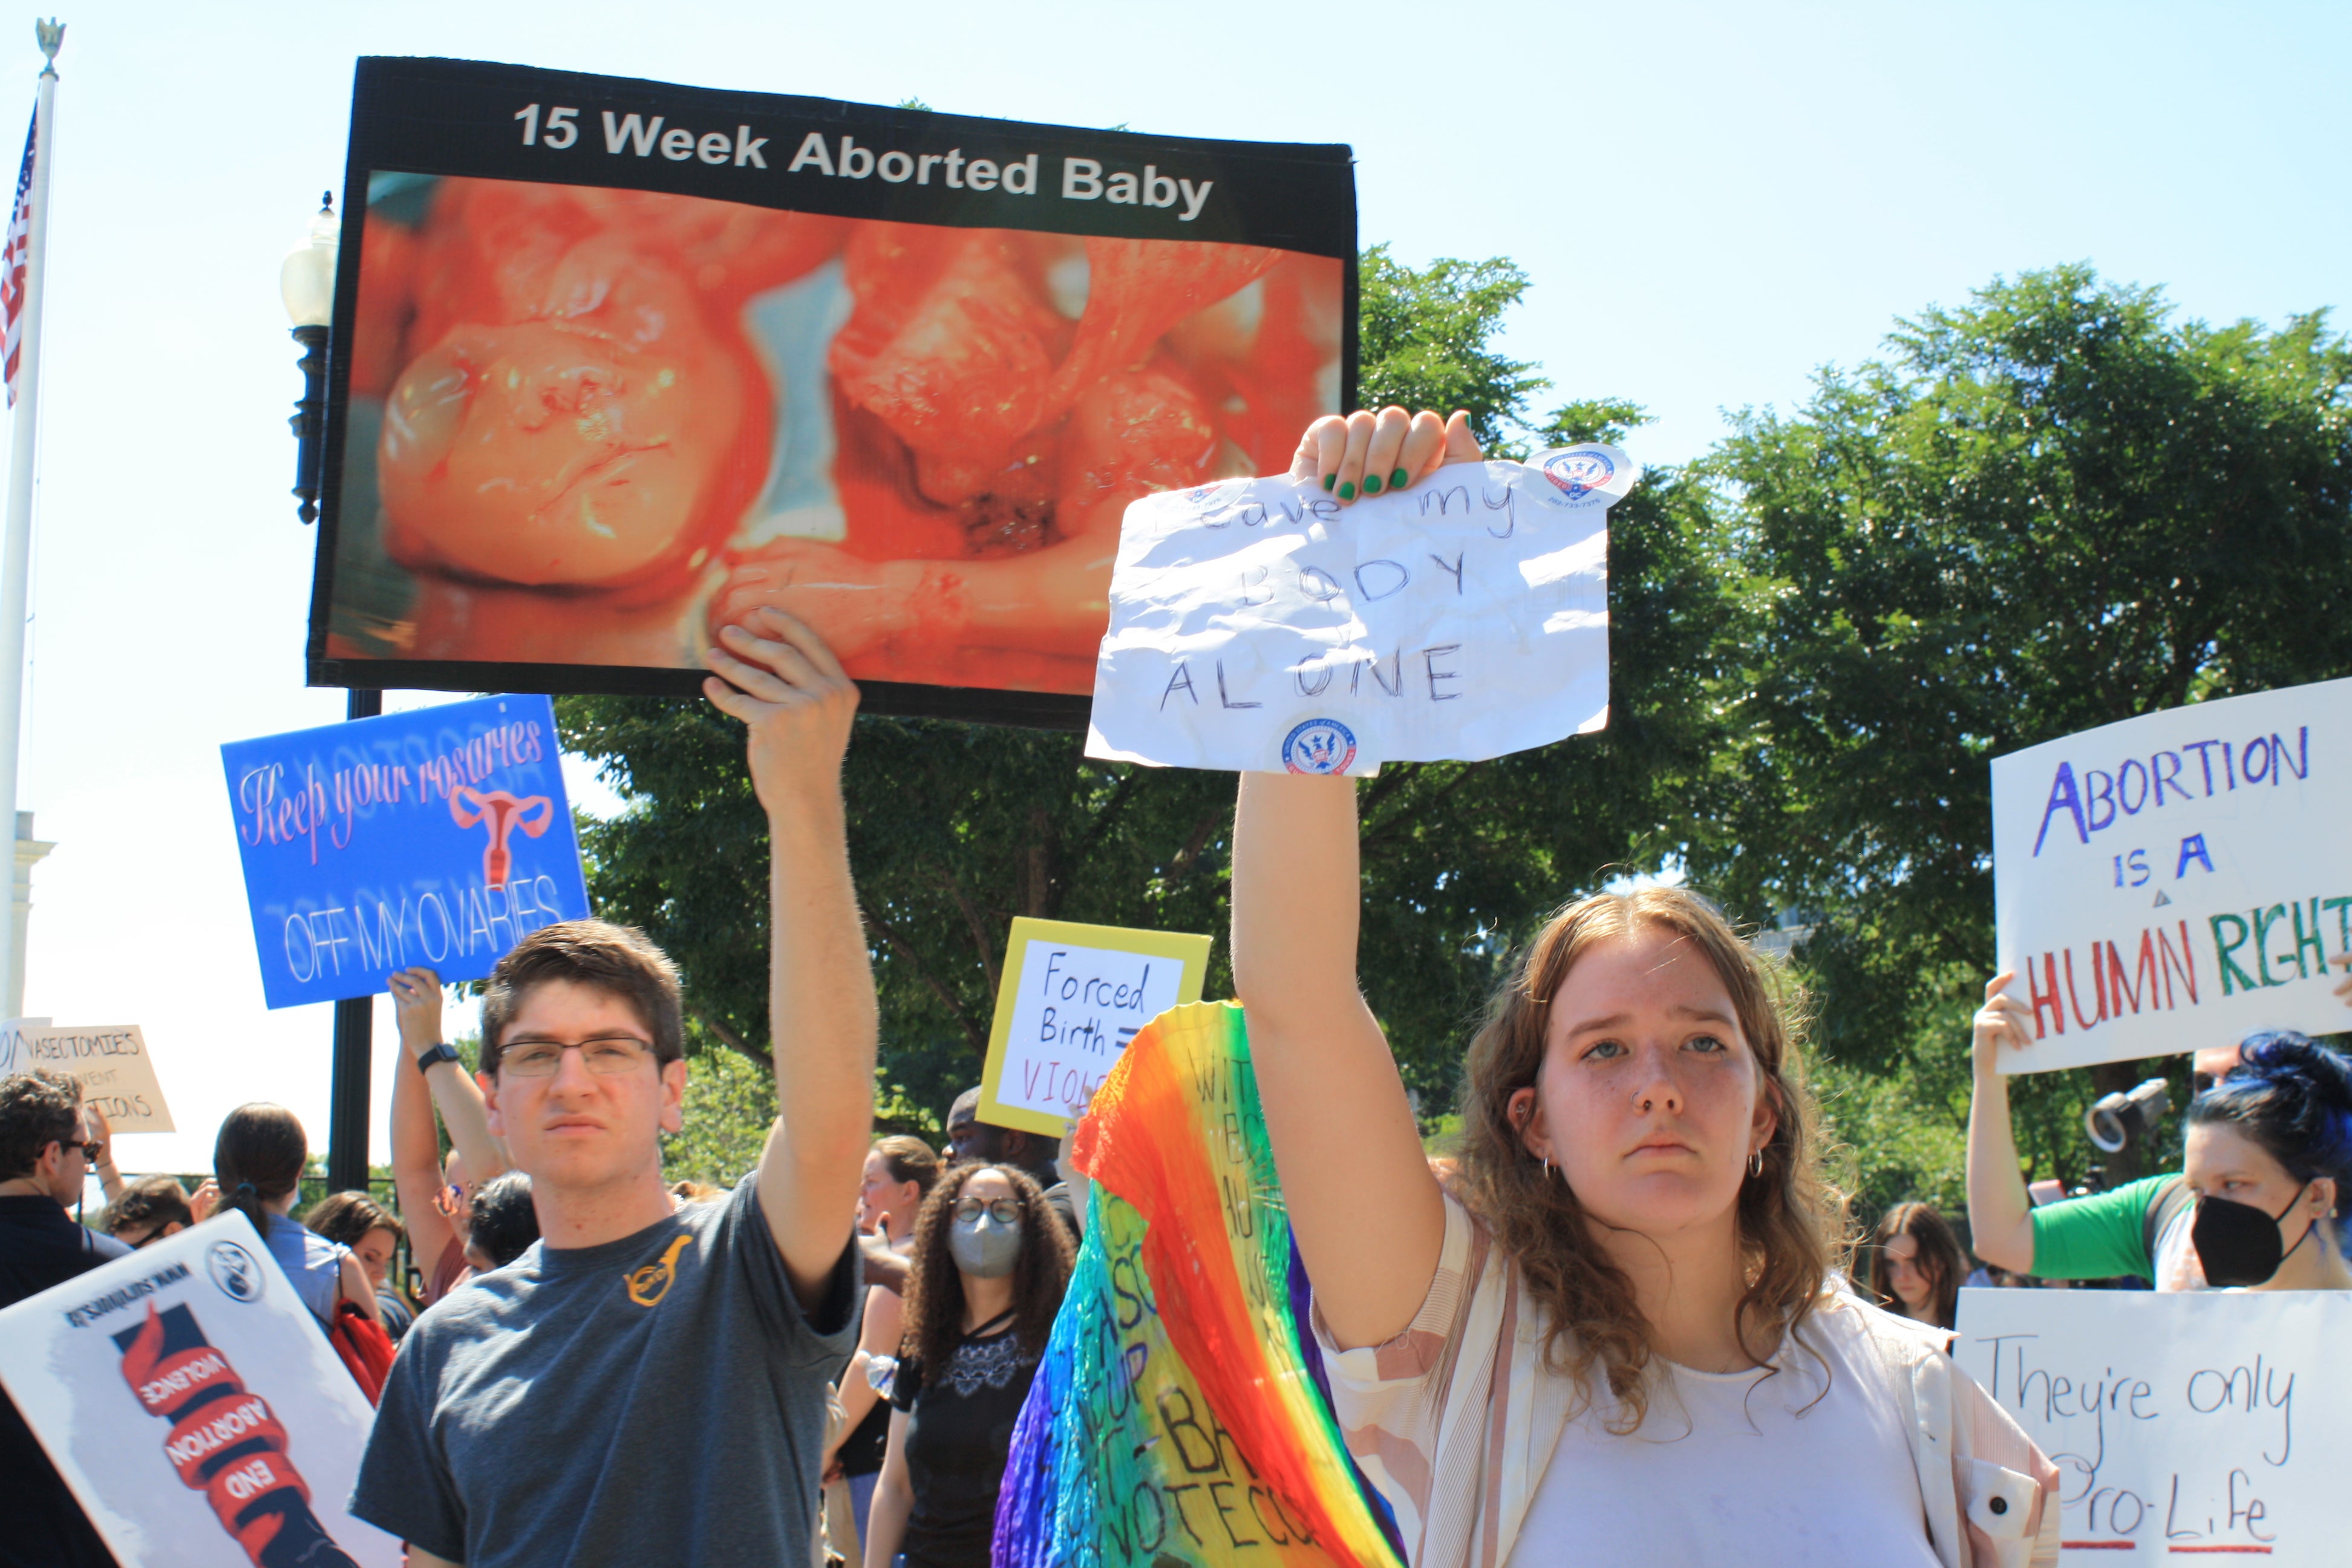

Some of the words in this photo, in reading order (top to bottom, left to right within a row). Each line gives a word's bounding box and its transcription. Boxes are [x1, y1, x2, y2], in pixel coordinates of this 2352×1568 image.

[514, 103, 580, 150] 15
[602, 111, 769, 169] Week
[789, 132, 1039, 195] Aborted
[1062, 157, 1214, 221] Baby
[1417, 482, 1515, 539] my
[1241, 551, 1464, 607] BODY
[1159, 642, 1463, 713] ALONE
[240, 762, 325, 866] Keep
[331, 763, 411, 849] your
[419, 702, 543, 804] rosaries
[2032, 725, 2309, 858] ABORTION
[2113, 848, 2151, 889] IS
[2175, 832, 2216, 880] A
[285, 908, 349, 983] OFF
[354, 898, 407, 972] MY
[417, 875, 563, 963] OVARIES
[1044, 951, 1150, 1014] Forced
[1040, 1006, 1105, 1057] Birth
[84, 1095, 152, 1118] TIONS
[139, 1353, 229, 1405] VIOLENCE
[1975, 1334, 2160, 1472] They're
[2187, 1353, 2295, 1467] only
[164, 1397, 269, 1467] ABORTION
[224, 1459, 276, 1500] END
